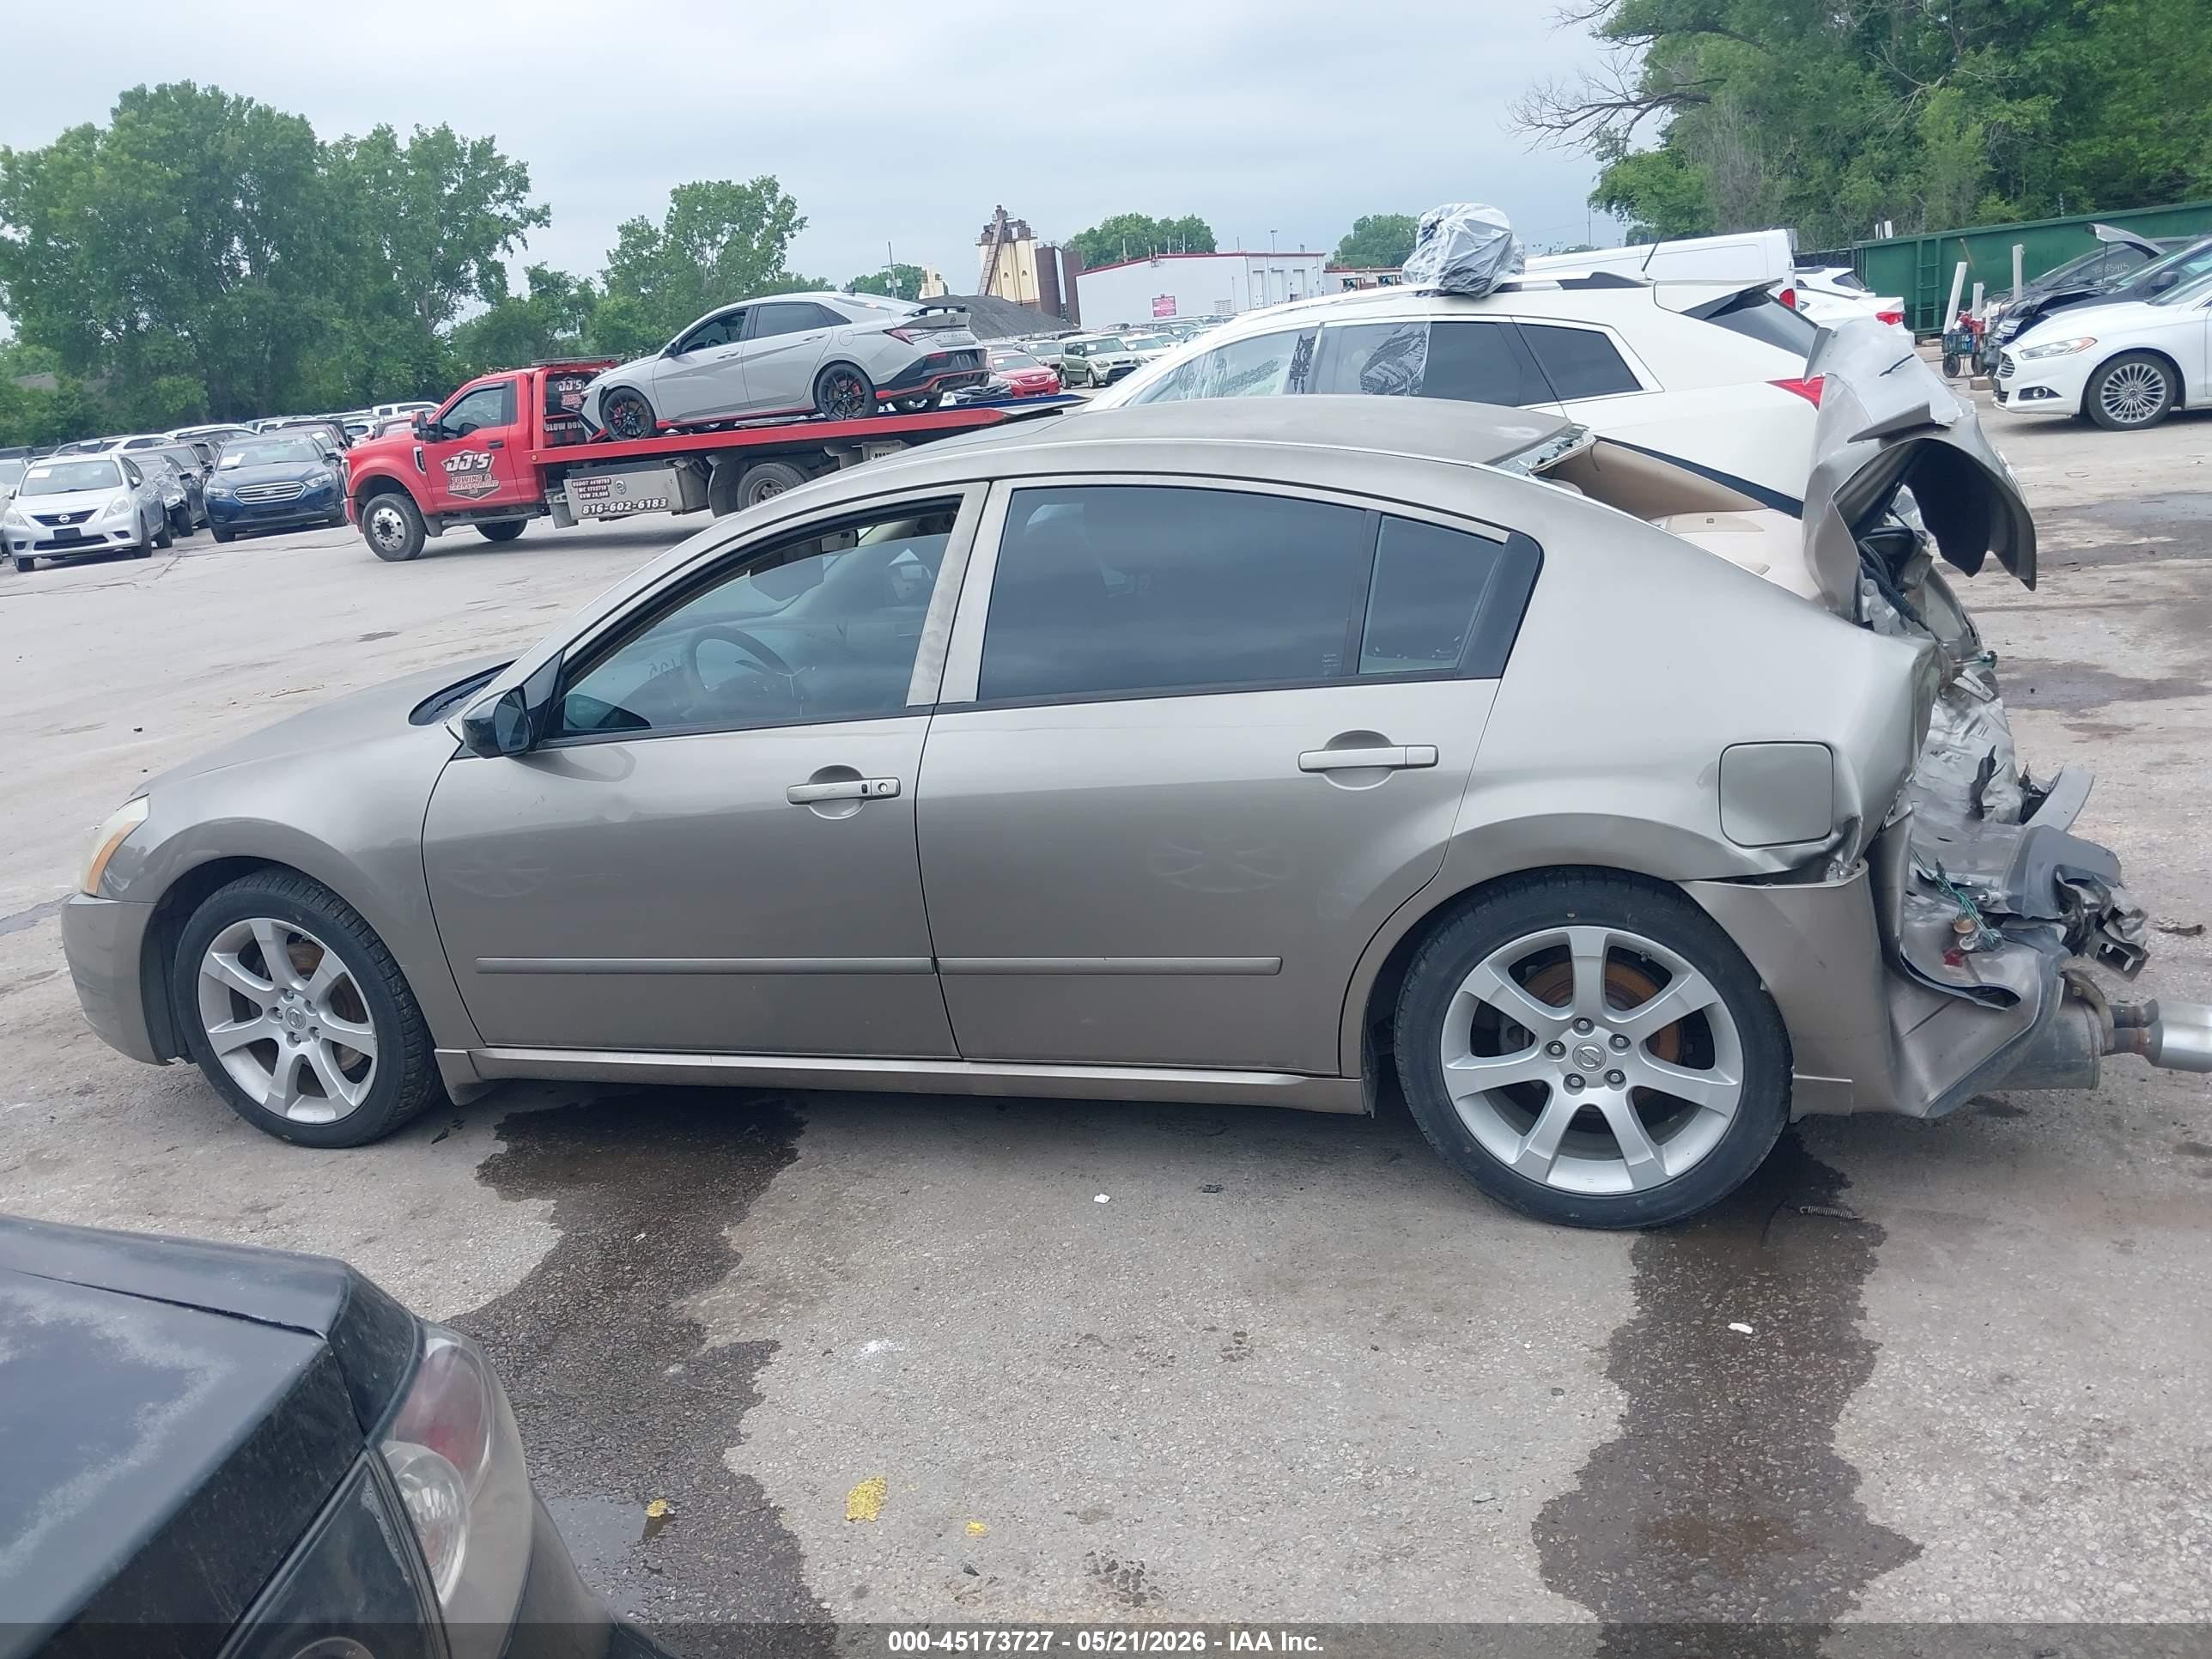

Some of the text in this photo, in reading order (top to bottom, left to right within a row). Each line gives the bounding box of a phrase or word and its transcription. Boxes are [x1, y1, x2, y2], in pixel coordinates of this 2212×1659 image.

[545, 422, 566, 431] SLOW
[446, 453, 490, 471] JJ'S
[452, 474, 483, 484] TOWING
[582, 498, 667, 514] 816-602-6183
